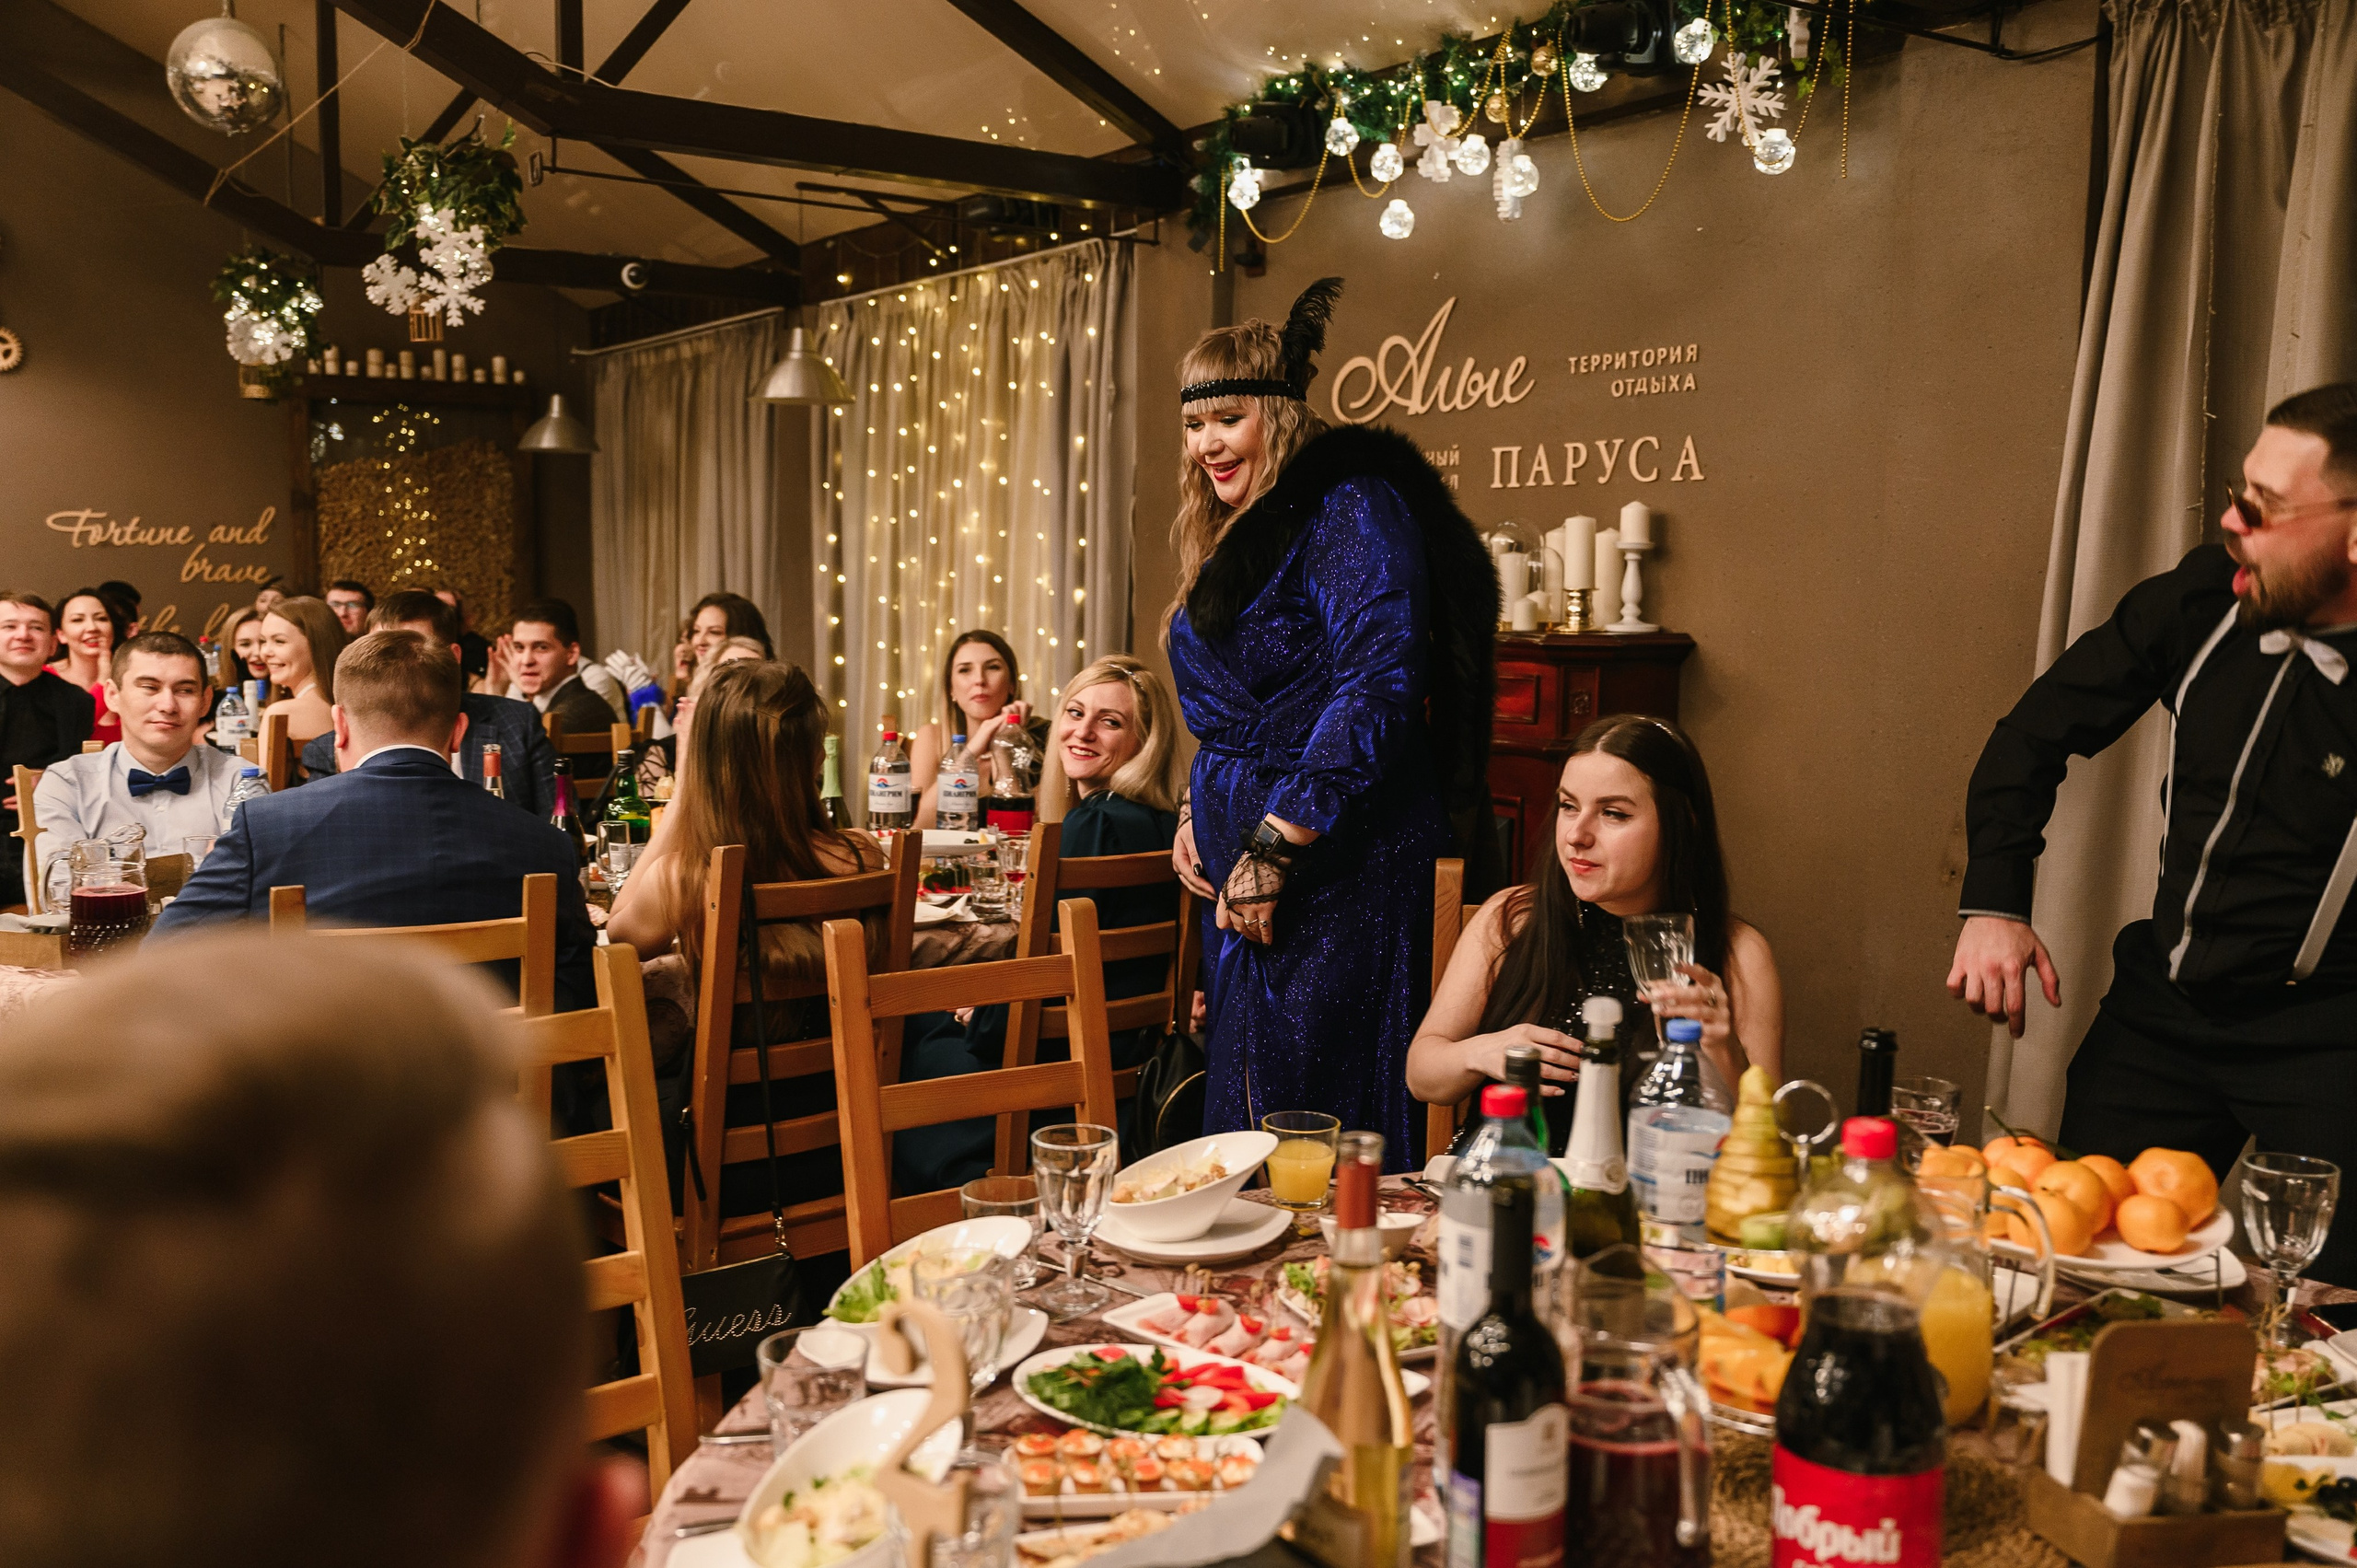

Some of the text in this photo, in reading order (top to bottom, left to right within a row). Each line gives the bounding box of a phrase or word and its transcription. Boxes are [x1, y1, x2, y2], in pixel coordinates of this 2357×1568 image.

[1331, 296, 1535, 424] Алые
[1568, 343, 1699, 375] ТЕРРИТОРИЯ
[1610, 373, 1697, 398] ОТДЫХА
[1490, 436, 1705, 489] ПАРУСА
[46, 505, 276, 548] Fortune and
[180, 543, 273, 585] brave
